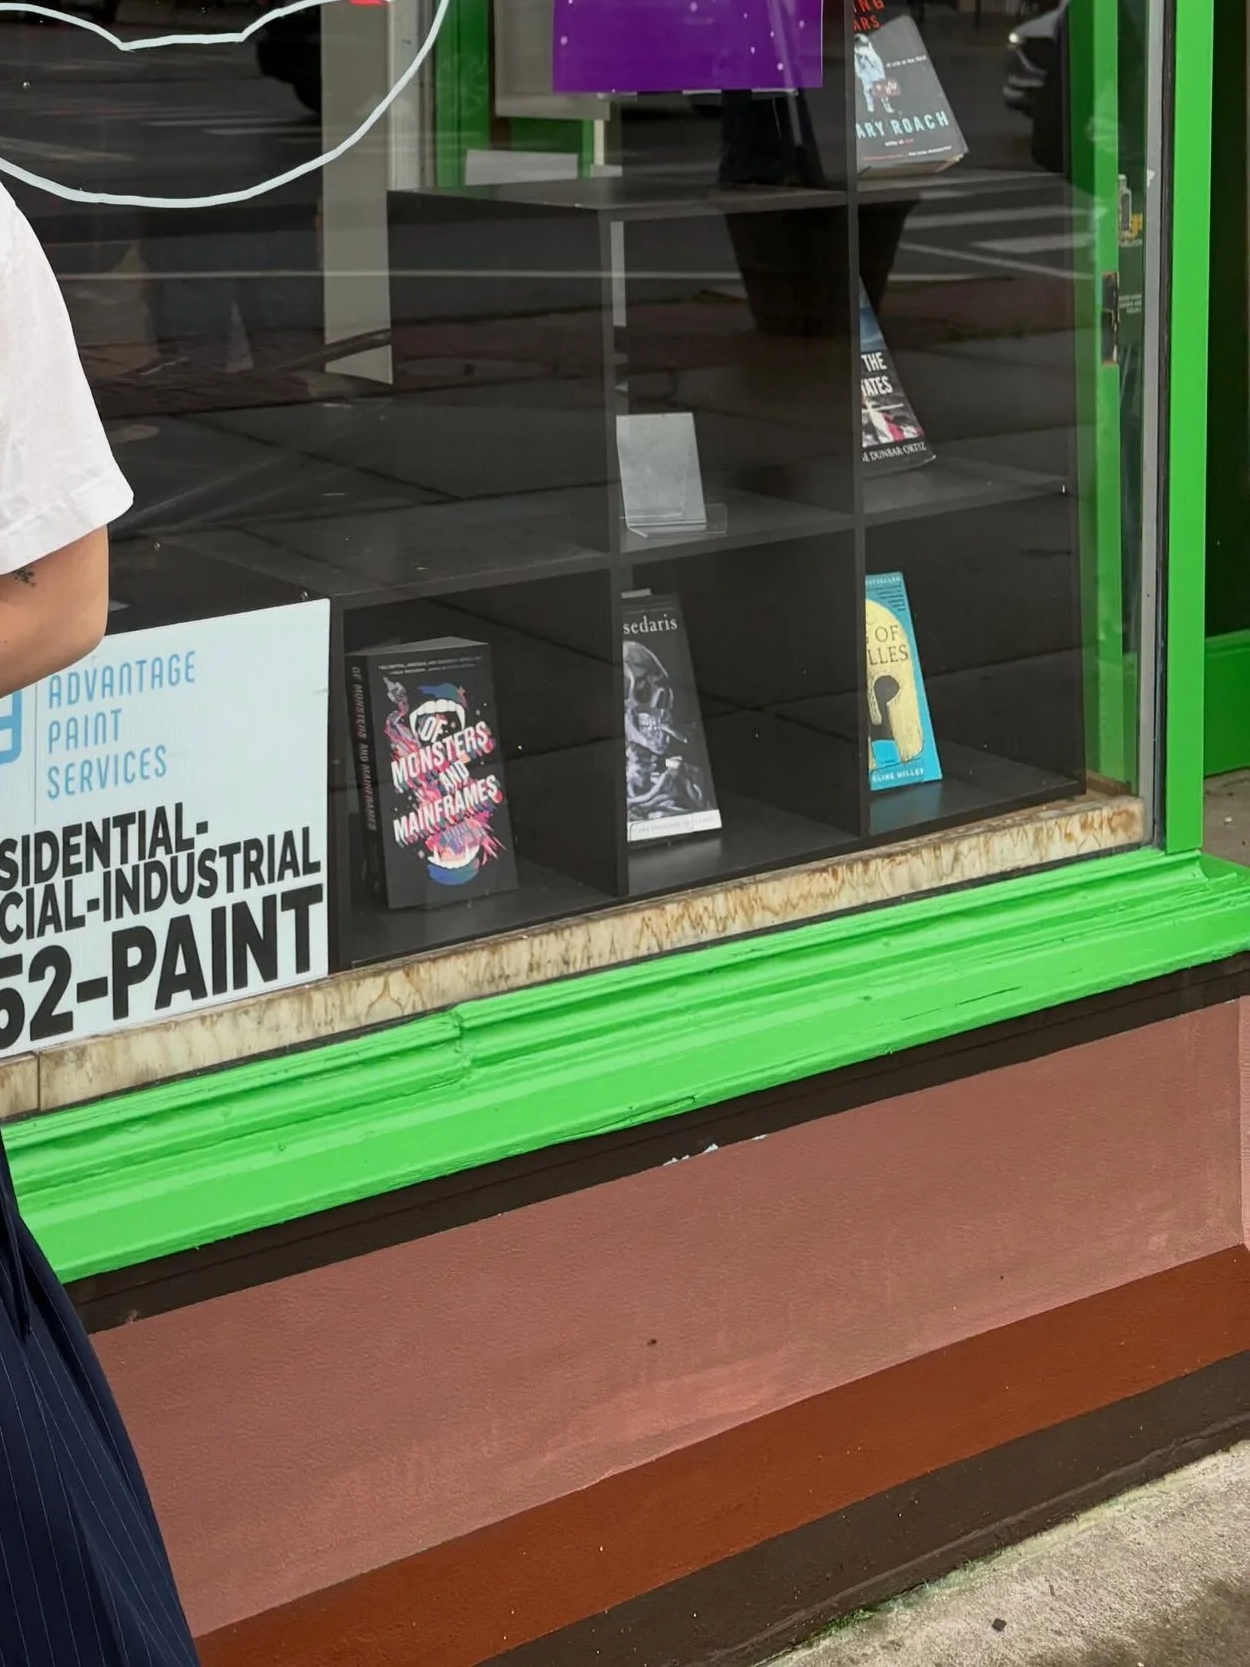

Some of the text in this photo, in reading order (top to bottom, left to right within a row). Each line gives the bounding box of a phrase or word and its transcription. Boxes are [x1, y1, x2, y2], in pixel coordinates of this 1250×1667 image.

[890, 111, 949, 134] ROACH
[861, 352, 887, 372] THE
[623, 614, 678, 635] sedaris
[875, 624, 898, 643] OF
[49, 650, 196, 710] ADVANTAGE
[48, 708, 122, 754] PAINT
[420, 716, 448, 743] OF
[47, 745, 168, 799] SERVICES
[391, 721, 491, 793] MONSTERS
[439, 760, 470, 791] AND
[393, 775, 500, 845] MAINFRAMES
